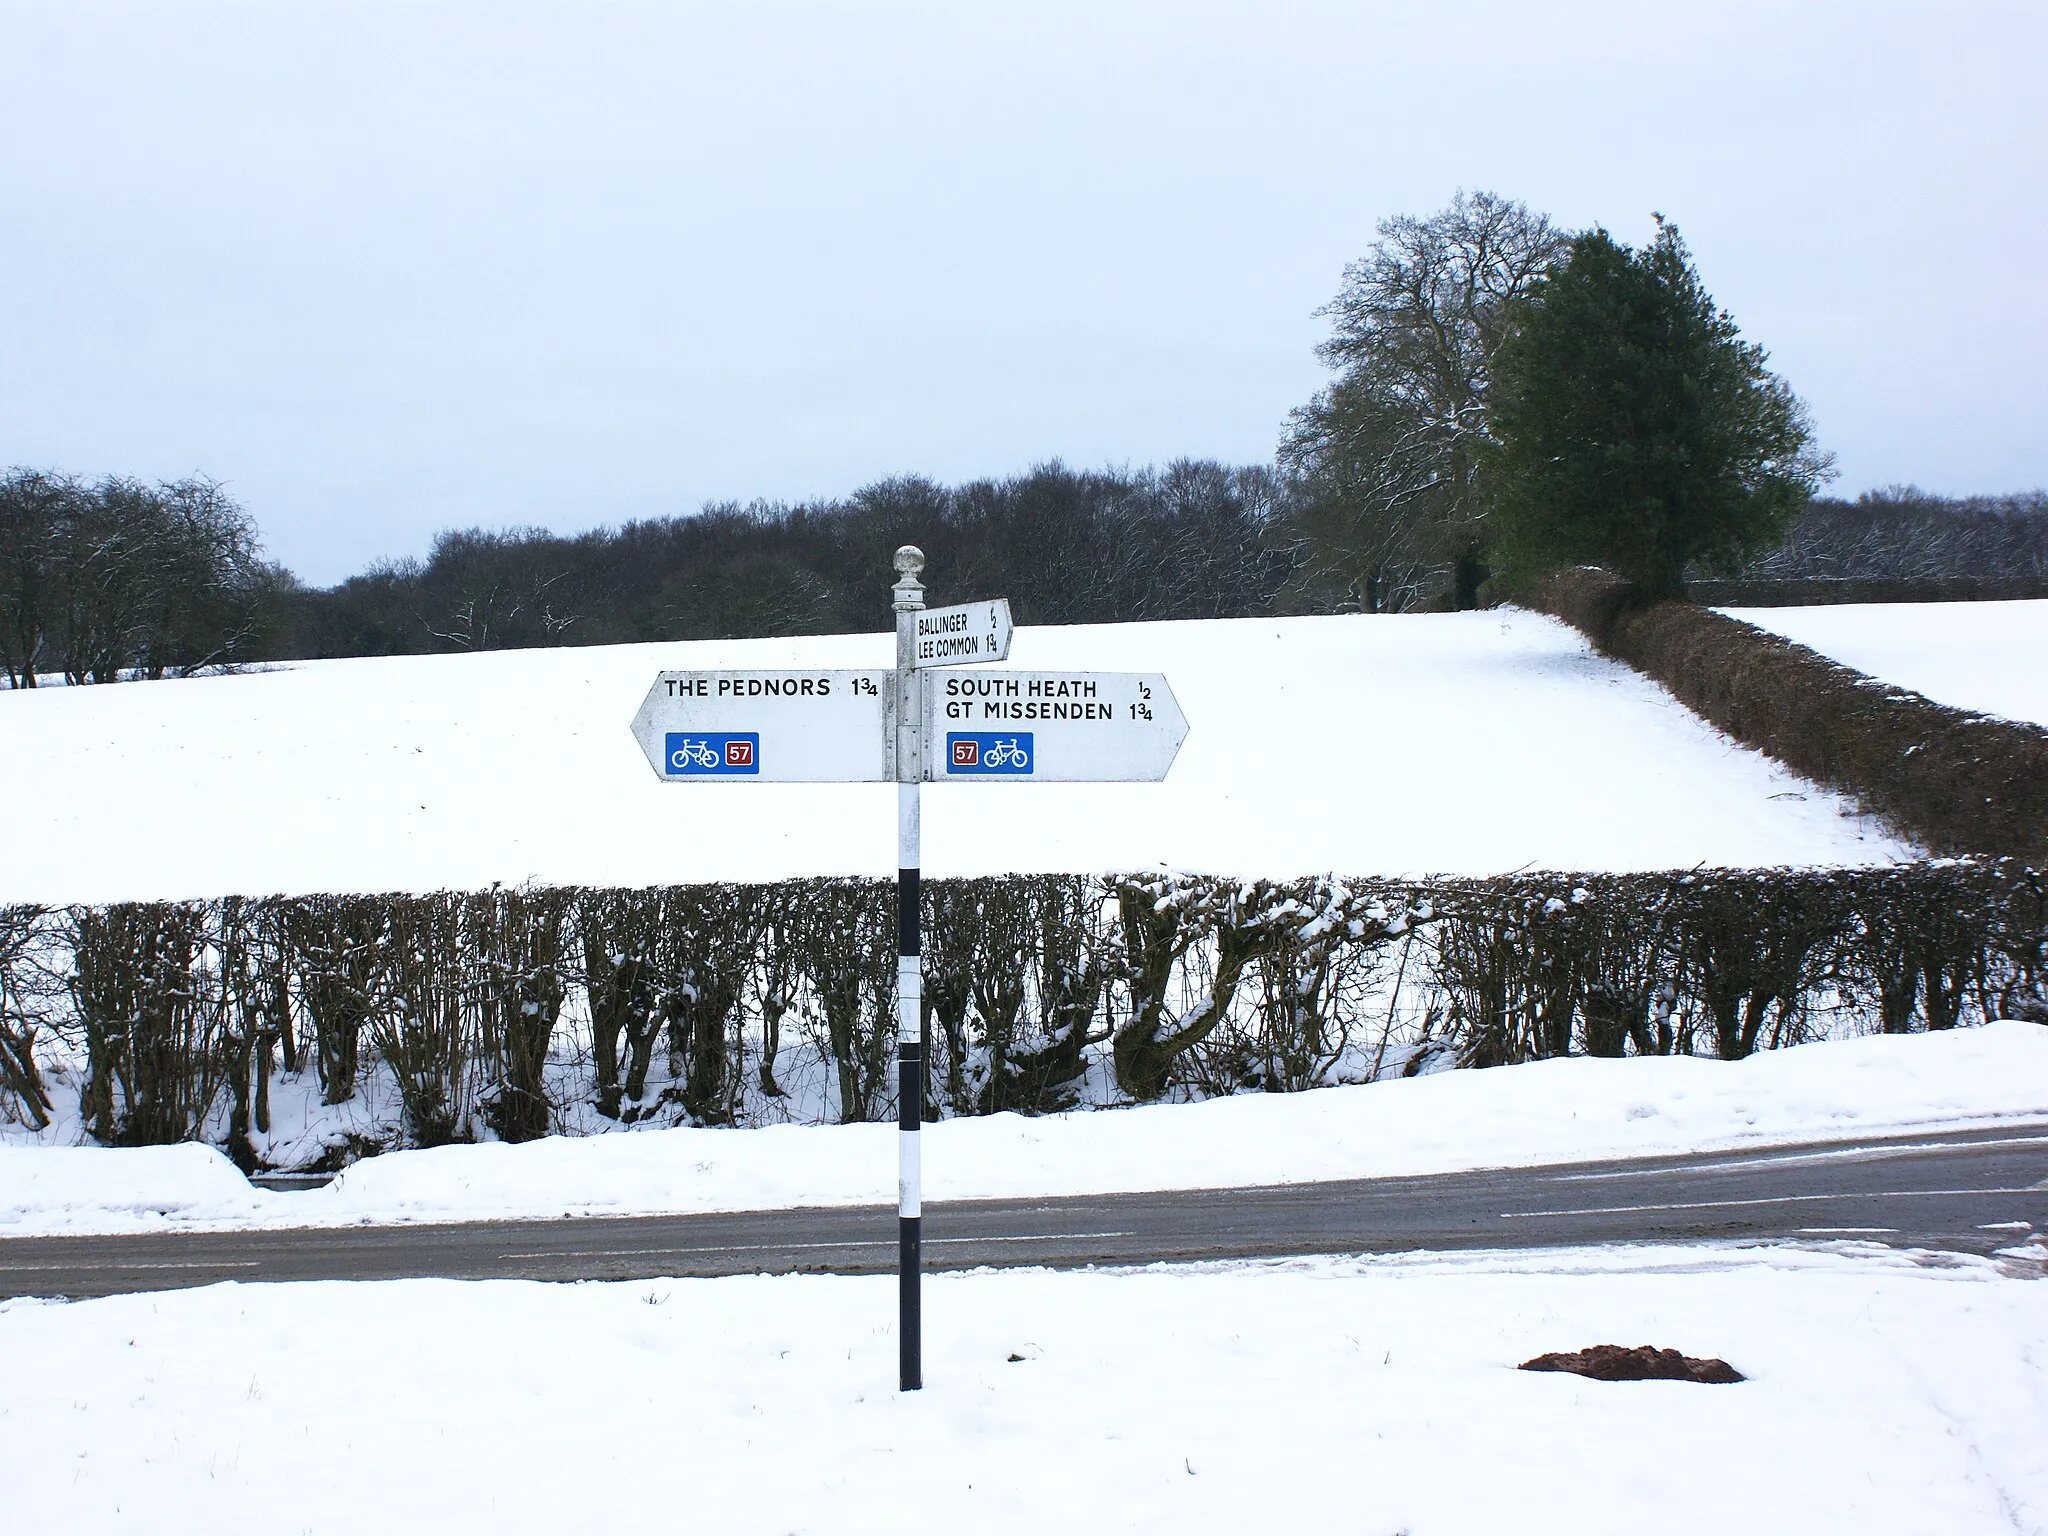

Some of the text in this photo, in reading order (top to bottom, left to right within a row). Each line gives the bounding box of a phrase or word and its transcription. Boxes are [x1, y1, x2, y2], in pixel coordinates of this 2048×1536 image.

[919, 613, 967, 636] BALLINGER
[919, 641, 934, 659] LEE
[936, 636, 978, 658] COMMON
[664, 679, 709, 697] THE
[718, 678, 831, 696] PEDNORS
[946, 679, 1019, 697] SOUTH
[1028, 679, 1097, 698] HEATH
[946, 701, 973, 719] GT
[984, 702, 1113, 720] MISSENDEN
[729, 746, 750, 761] 57
[955, 746, 975, 760] 57
